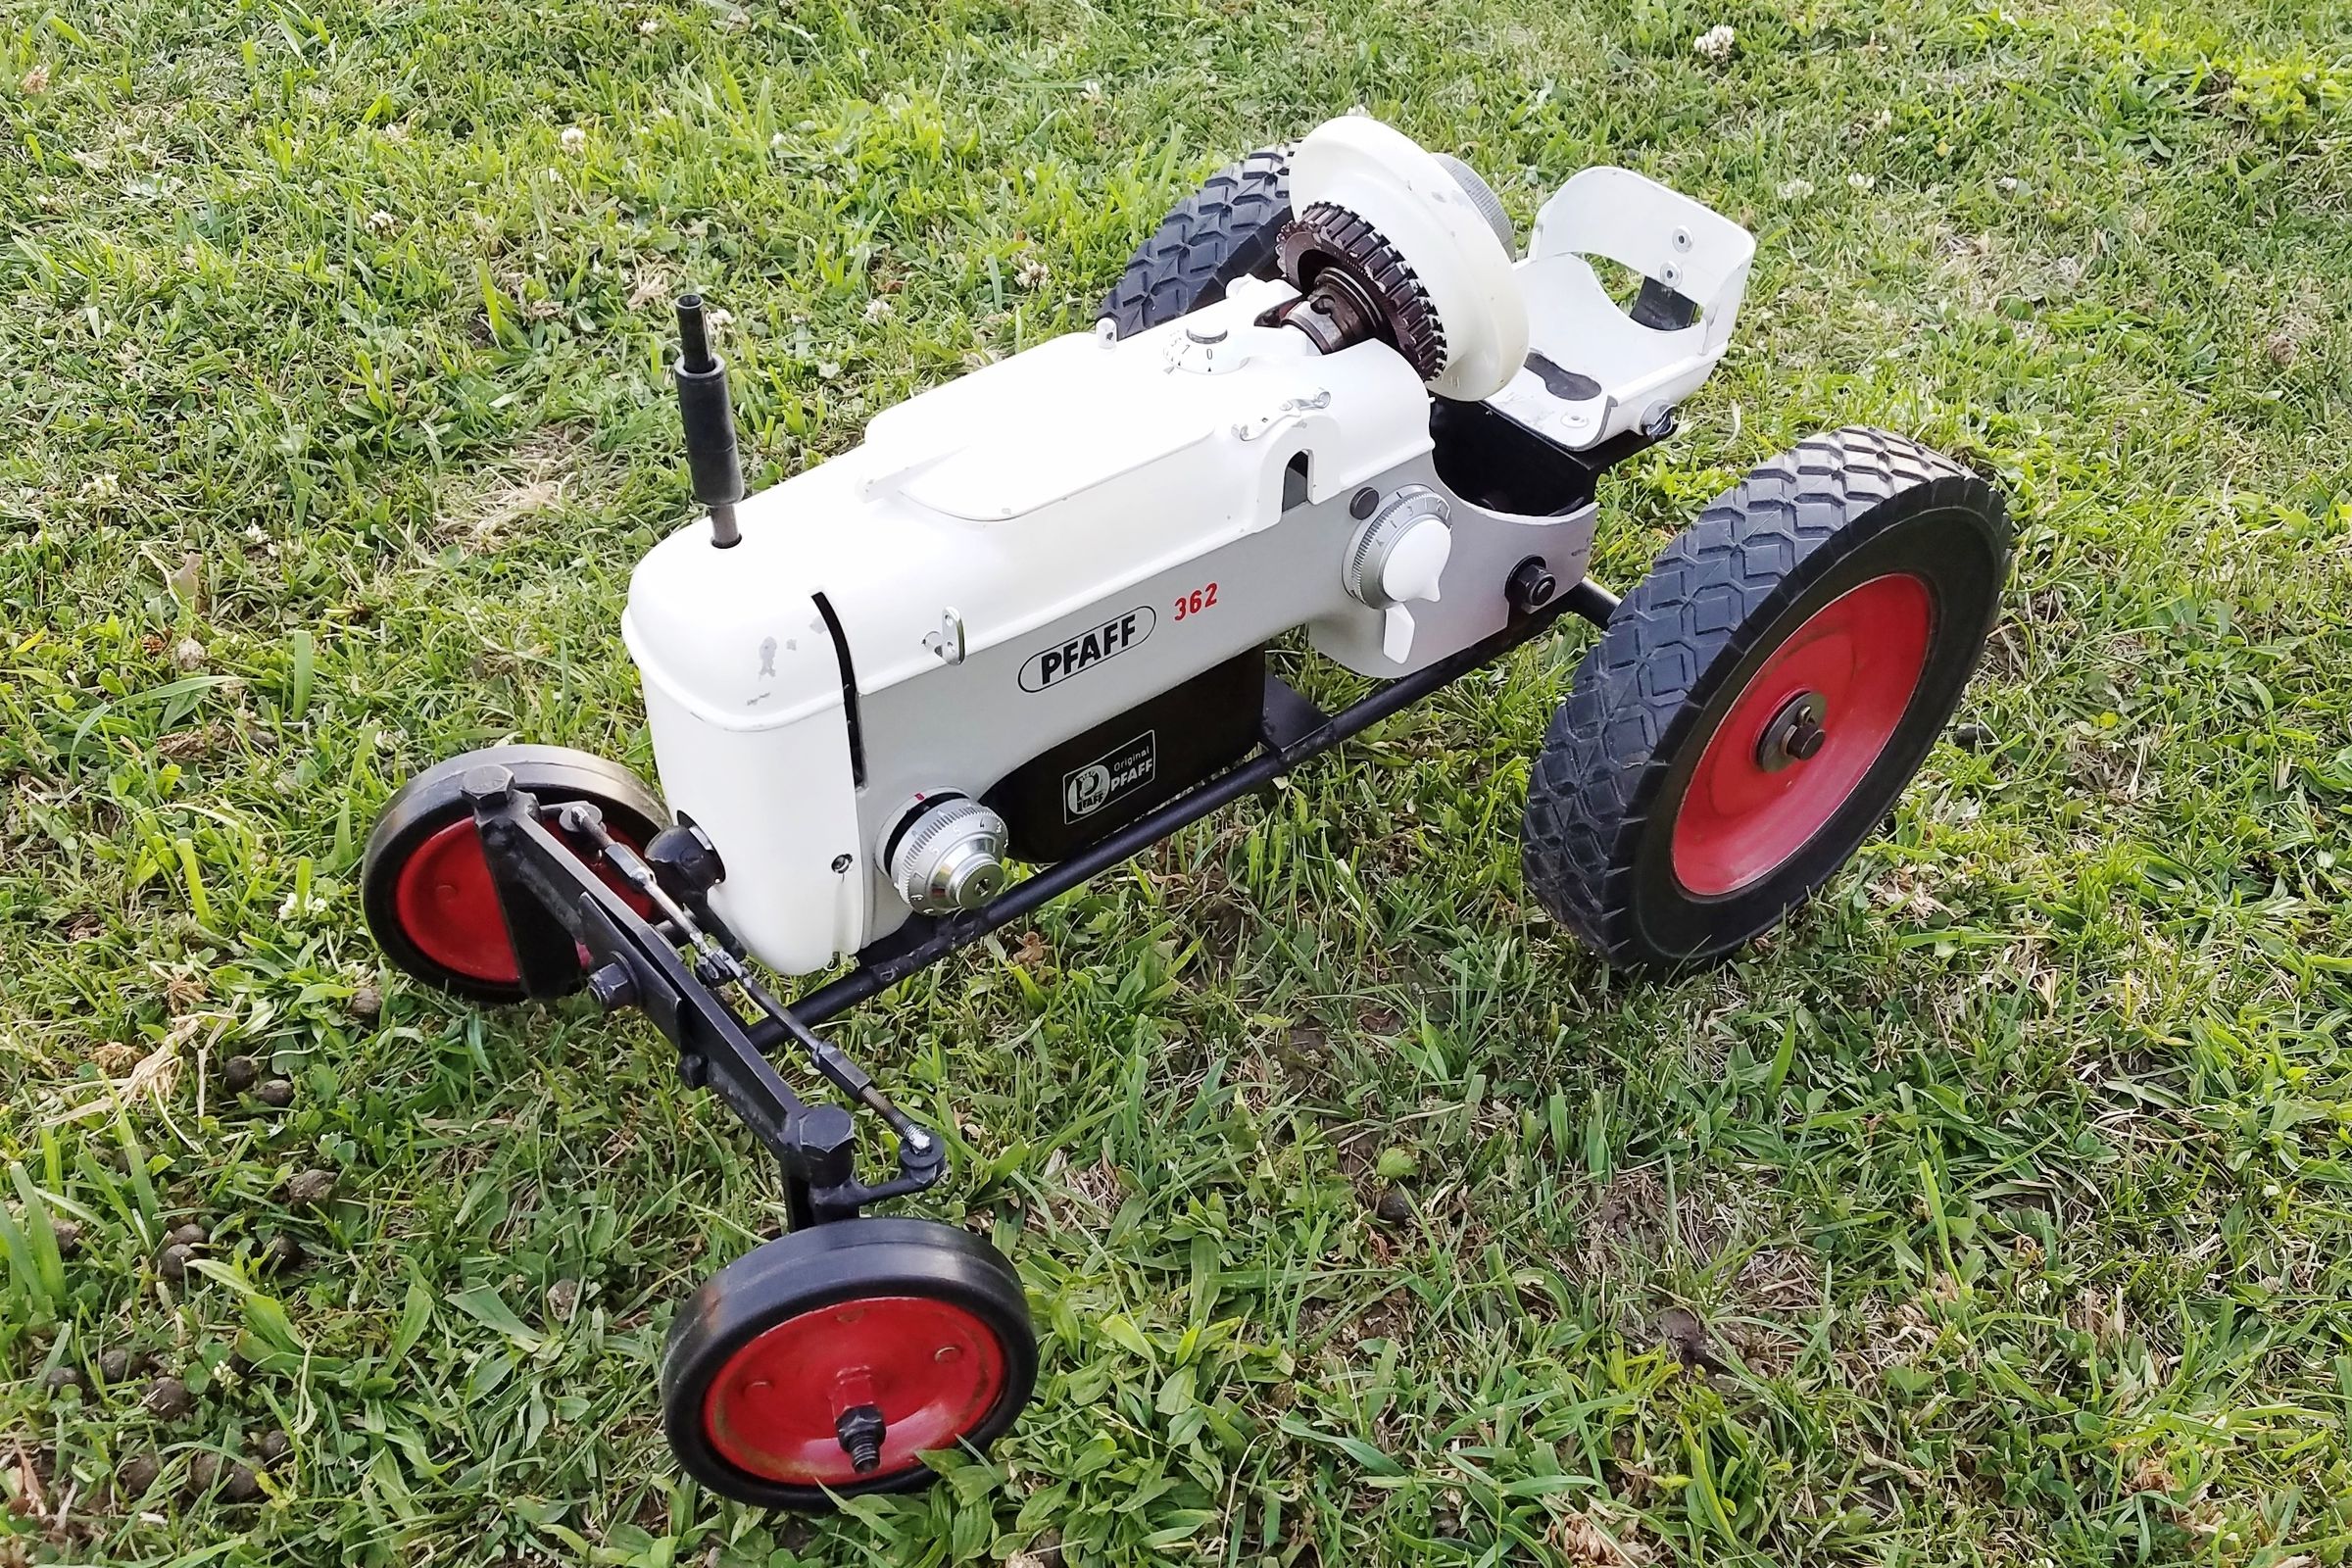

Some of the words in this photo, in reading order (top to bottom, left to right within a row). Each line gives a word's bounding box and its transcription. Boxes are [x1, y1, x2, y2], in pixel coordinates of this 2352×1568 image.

[1206, 348, 1213, 360] 0
[1173, 582, 1218, 621] 362
[1041, 613, 1137, 685] PFAFF
[1110, 758, 1152, 792] PFAFF
[1113, 745, 1151, 772] Original
